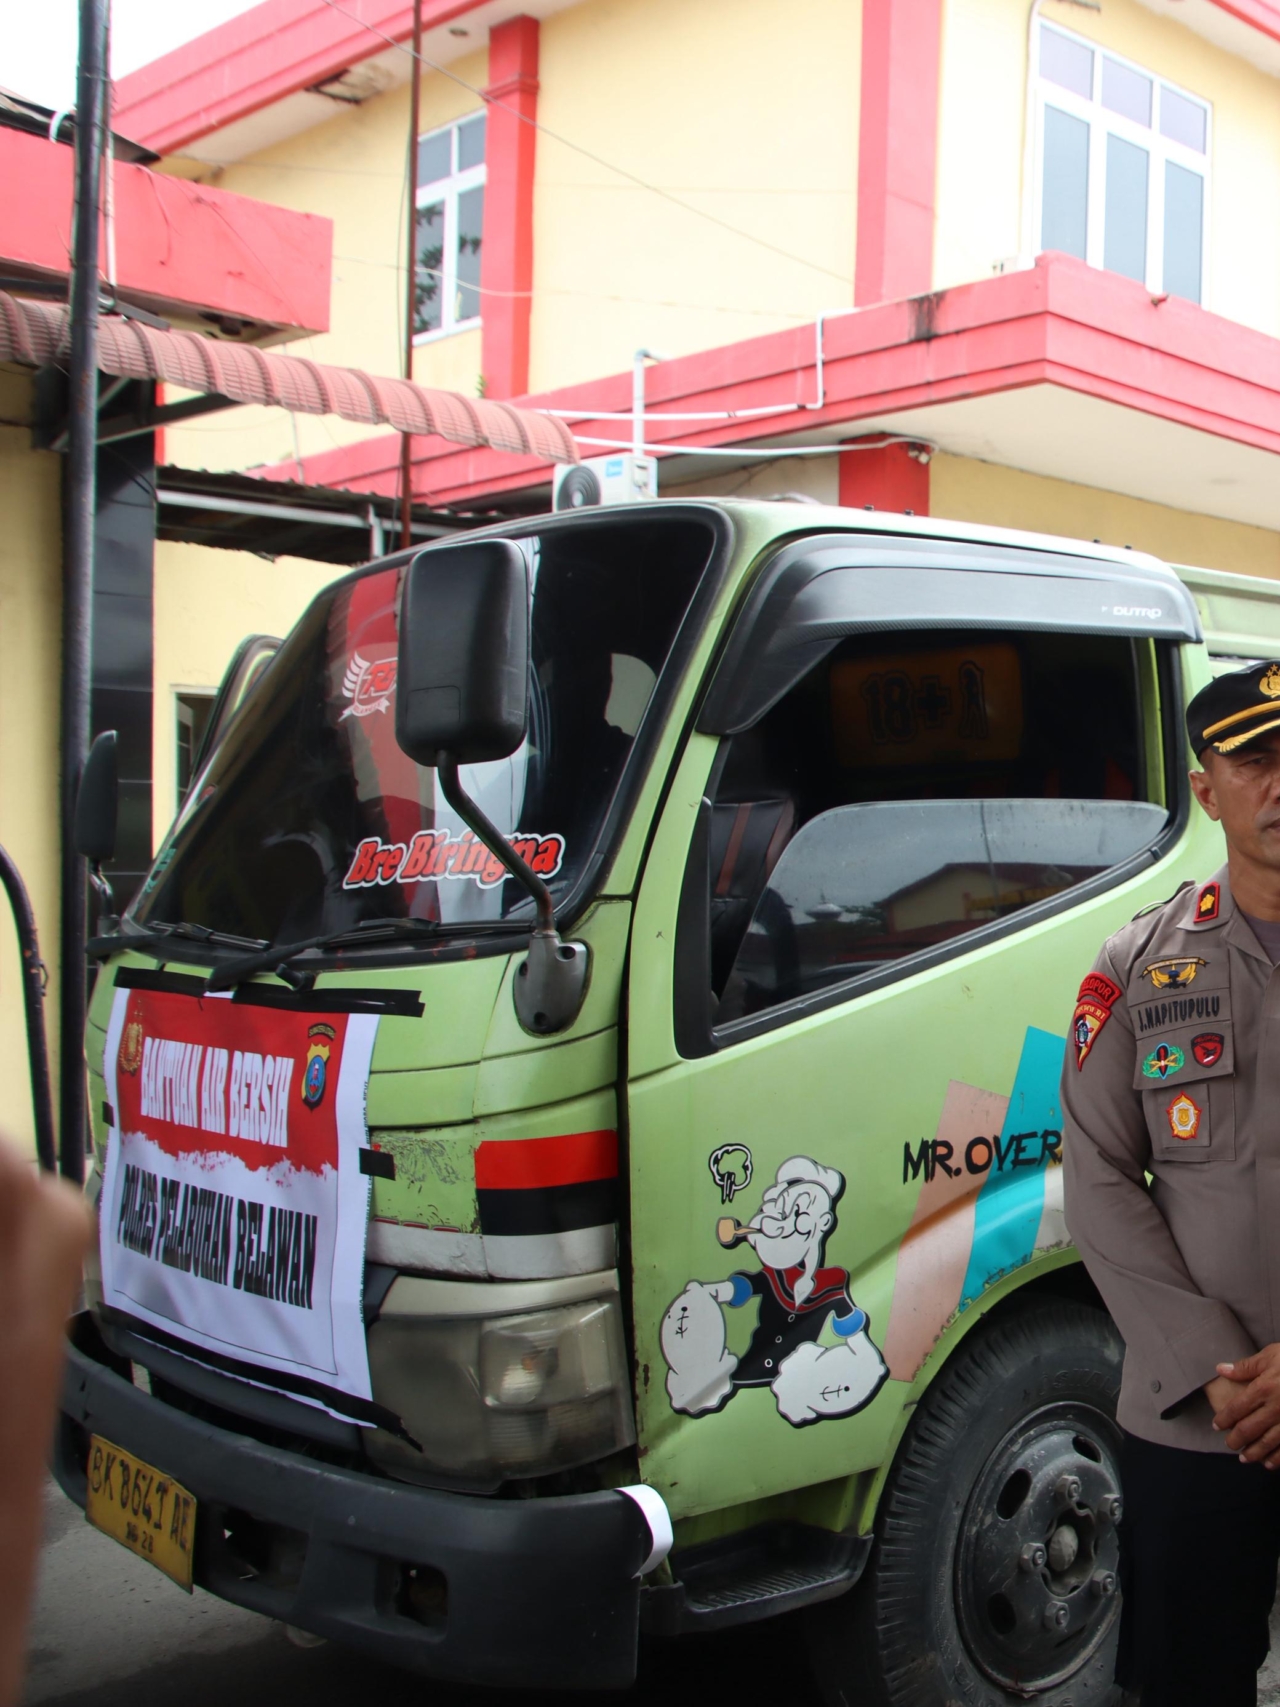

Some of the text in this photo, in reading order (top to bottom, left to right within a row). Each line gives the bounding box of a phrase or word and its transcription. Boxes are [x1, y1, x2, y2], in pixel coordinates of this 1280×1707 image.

[1112, 606, 1162, 620] DUTRO
[343, 837, 406, 889] Bre
[1137, 996, 1220, 1033] J.NAPITUPULU
[140, 1036, 203, 1128] BANTUAN
[201, 1045, 229, 1135] AIR
[229, 1050, 295, 1148] BERSIH
[902, 1129, 1063, 1185] MR.OVER
[117, 1163, 158, 1259] POLRES
[155, 1176, 234, 1286] PELABUHAN
[232, 1198, 318, 1310] BELAWAN
[92, 1445, 117, 1501] BK
